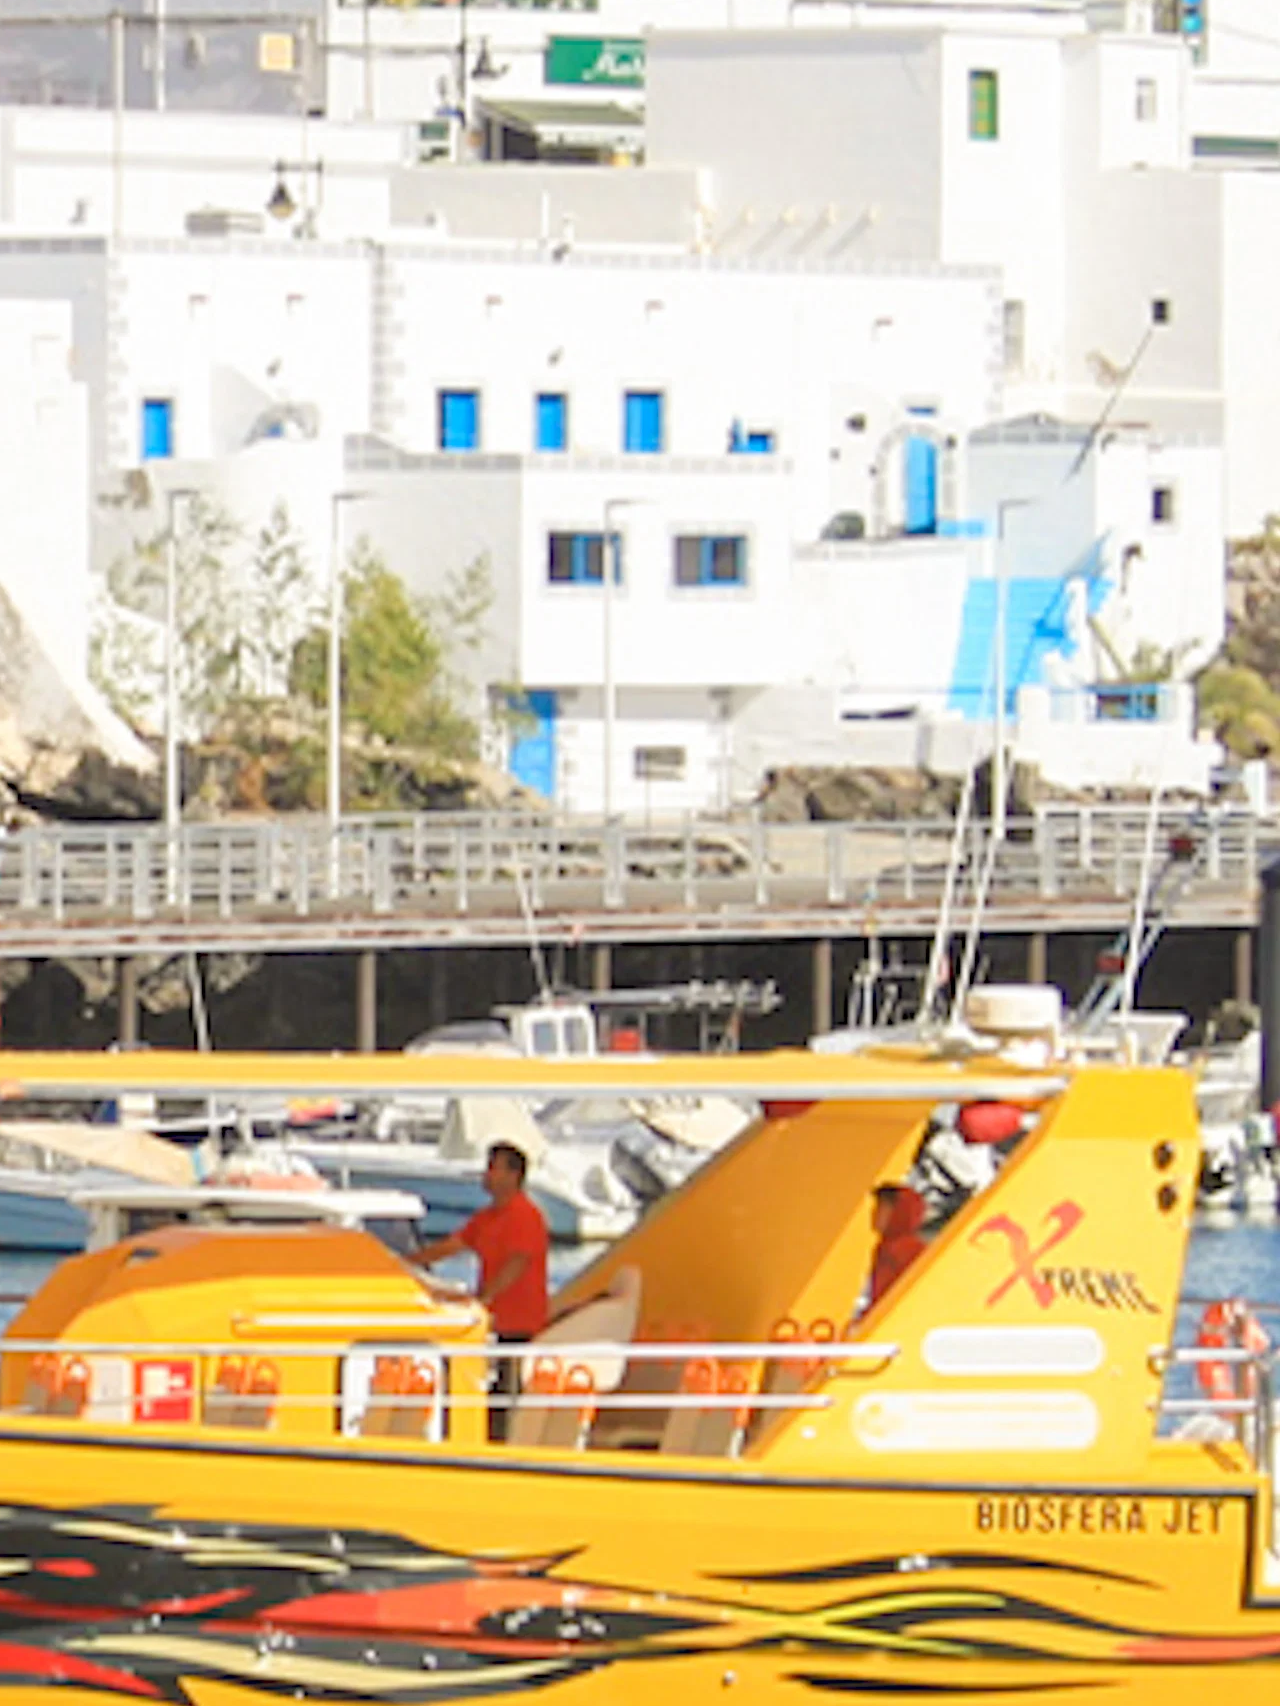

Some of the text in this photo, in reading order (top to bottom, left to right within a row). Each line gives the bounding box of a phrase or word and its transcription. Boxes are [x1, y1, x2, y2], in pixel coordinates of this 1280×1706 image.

[969, 1199, 1162, 1314] XTREME
[977, 1495, 1226, 1535] BIOSFERA JET
